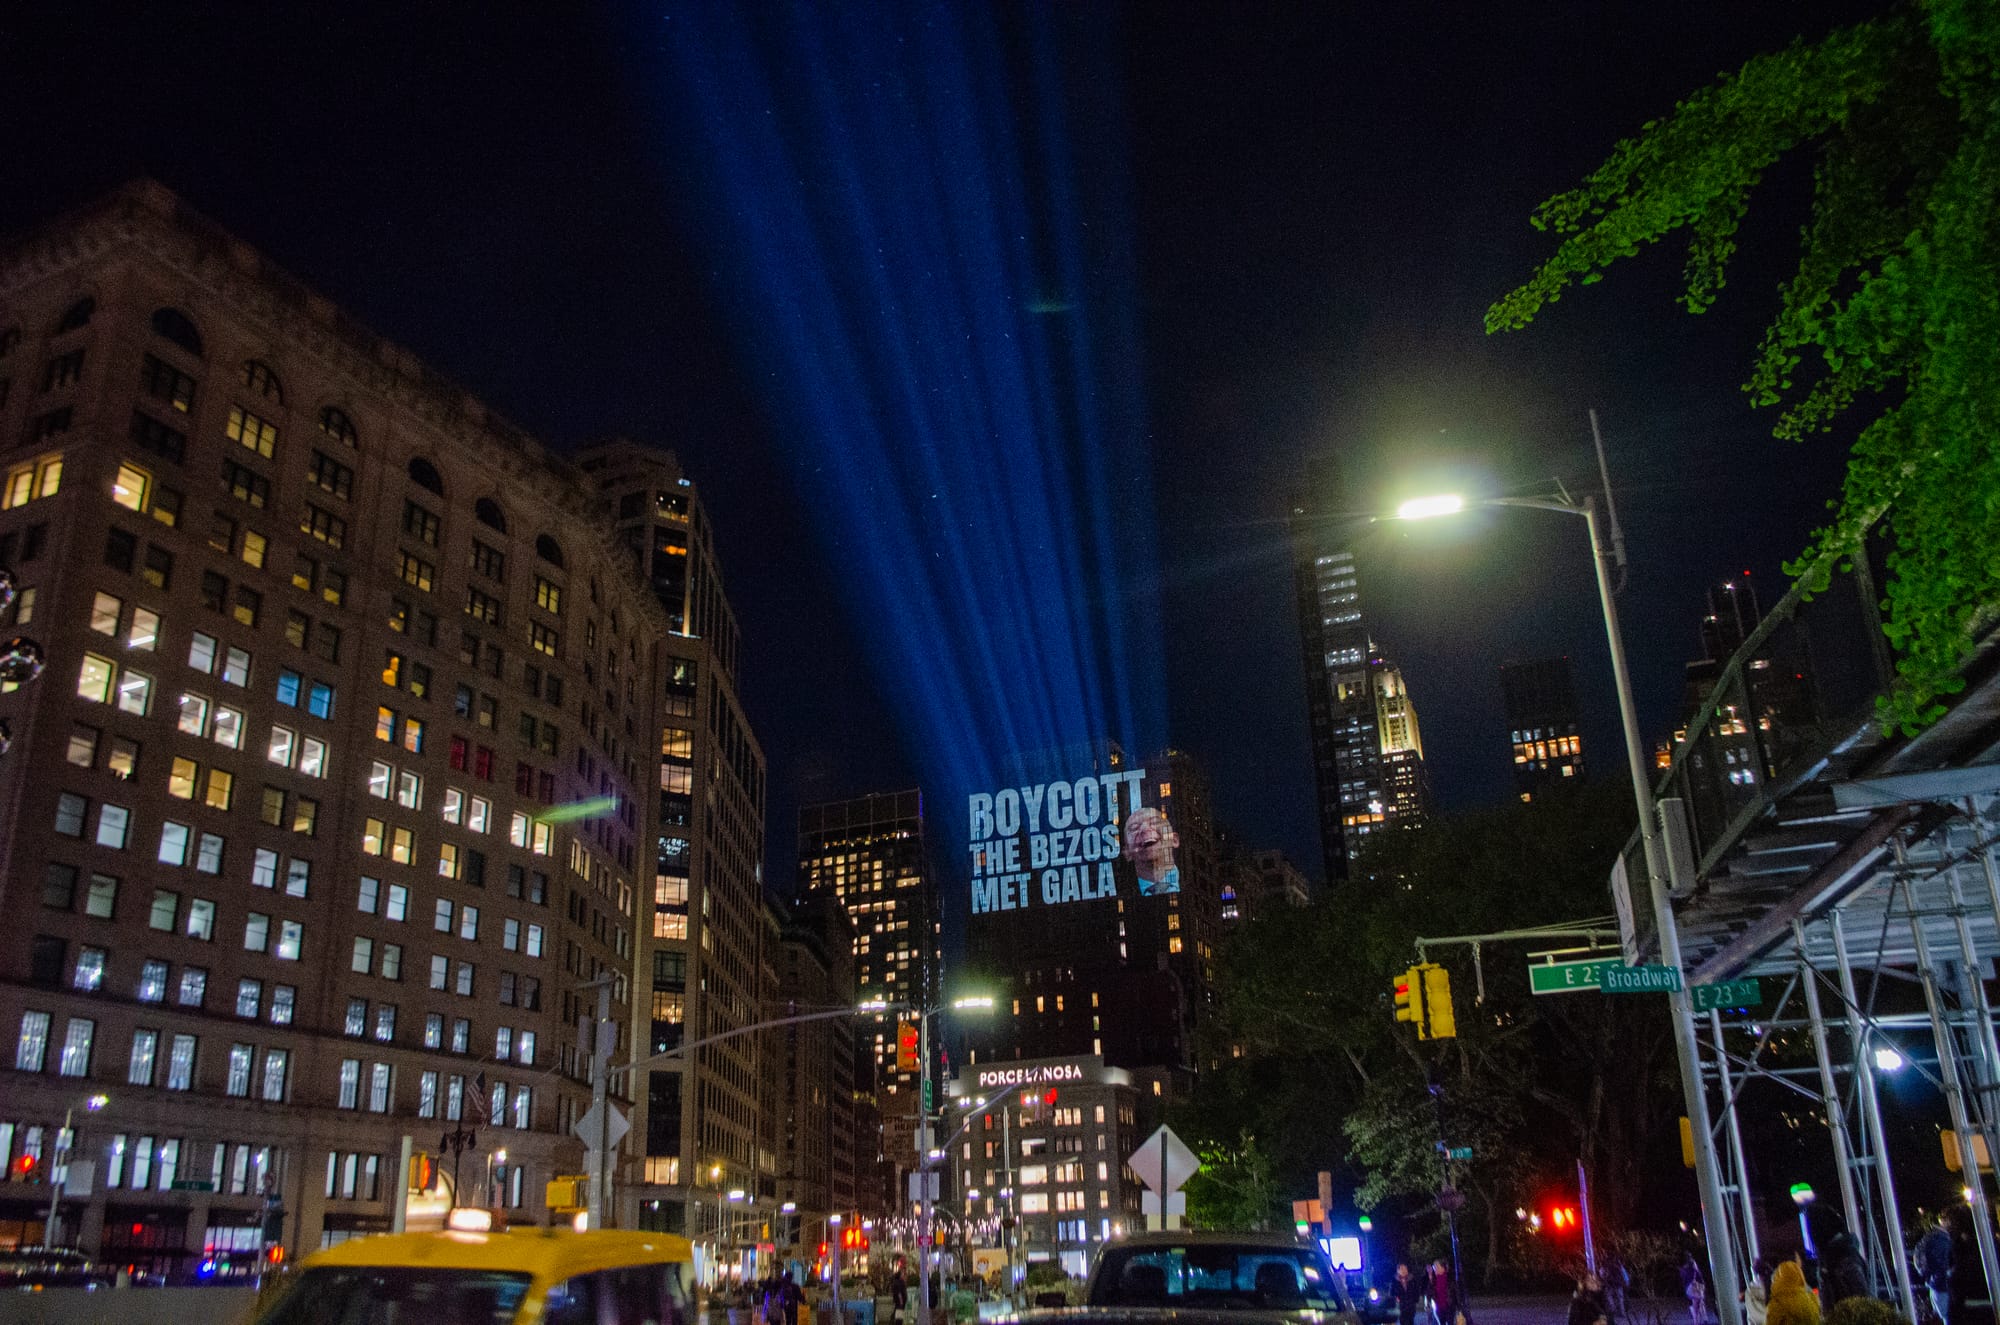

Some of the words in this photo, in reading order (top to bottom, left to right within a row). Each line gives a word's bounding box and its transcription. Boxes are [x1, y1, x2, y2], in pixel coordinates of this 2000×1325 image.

[969, 768, 1146, 841] BOYCOTT
[969, 837, 1021, 877] THE
[1030, 824, 1121, 870] BEZOS
[971, 873, 1031, 914] MET
[1041, 862, 1117, 905] GALA
[1565, 968, 1575, 985] E
[1607, 967, 1677, 991] Broadway
[1697, 988, 1707, 1007] E
[1714, 985, 1733, 1005] 23
[979, 1064, 1082, 1087] PORCELANOSA
